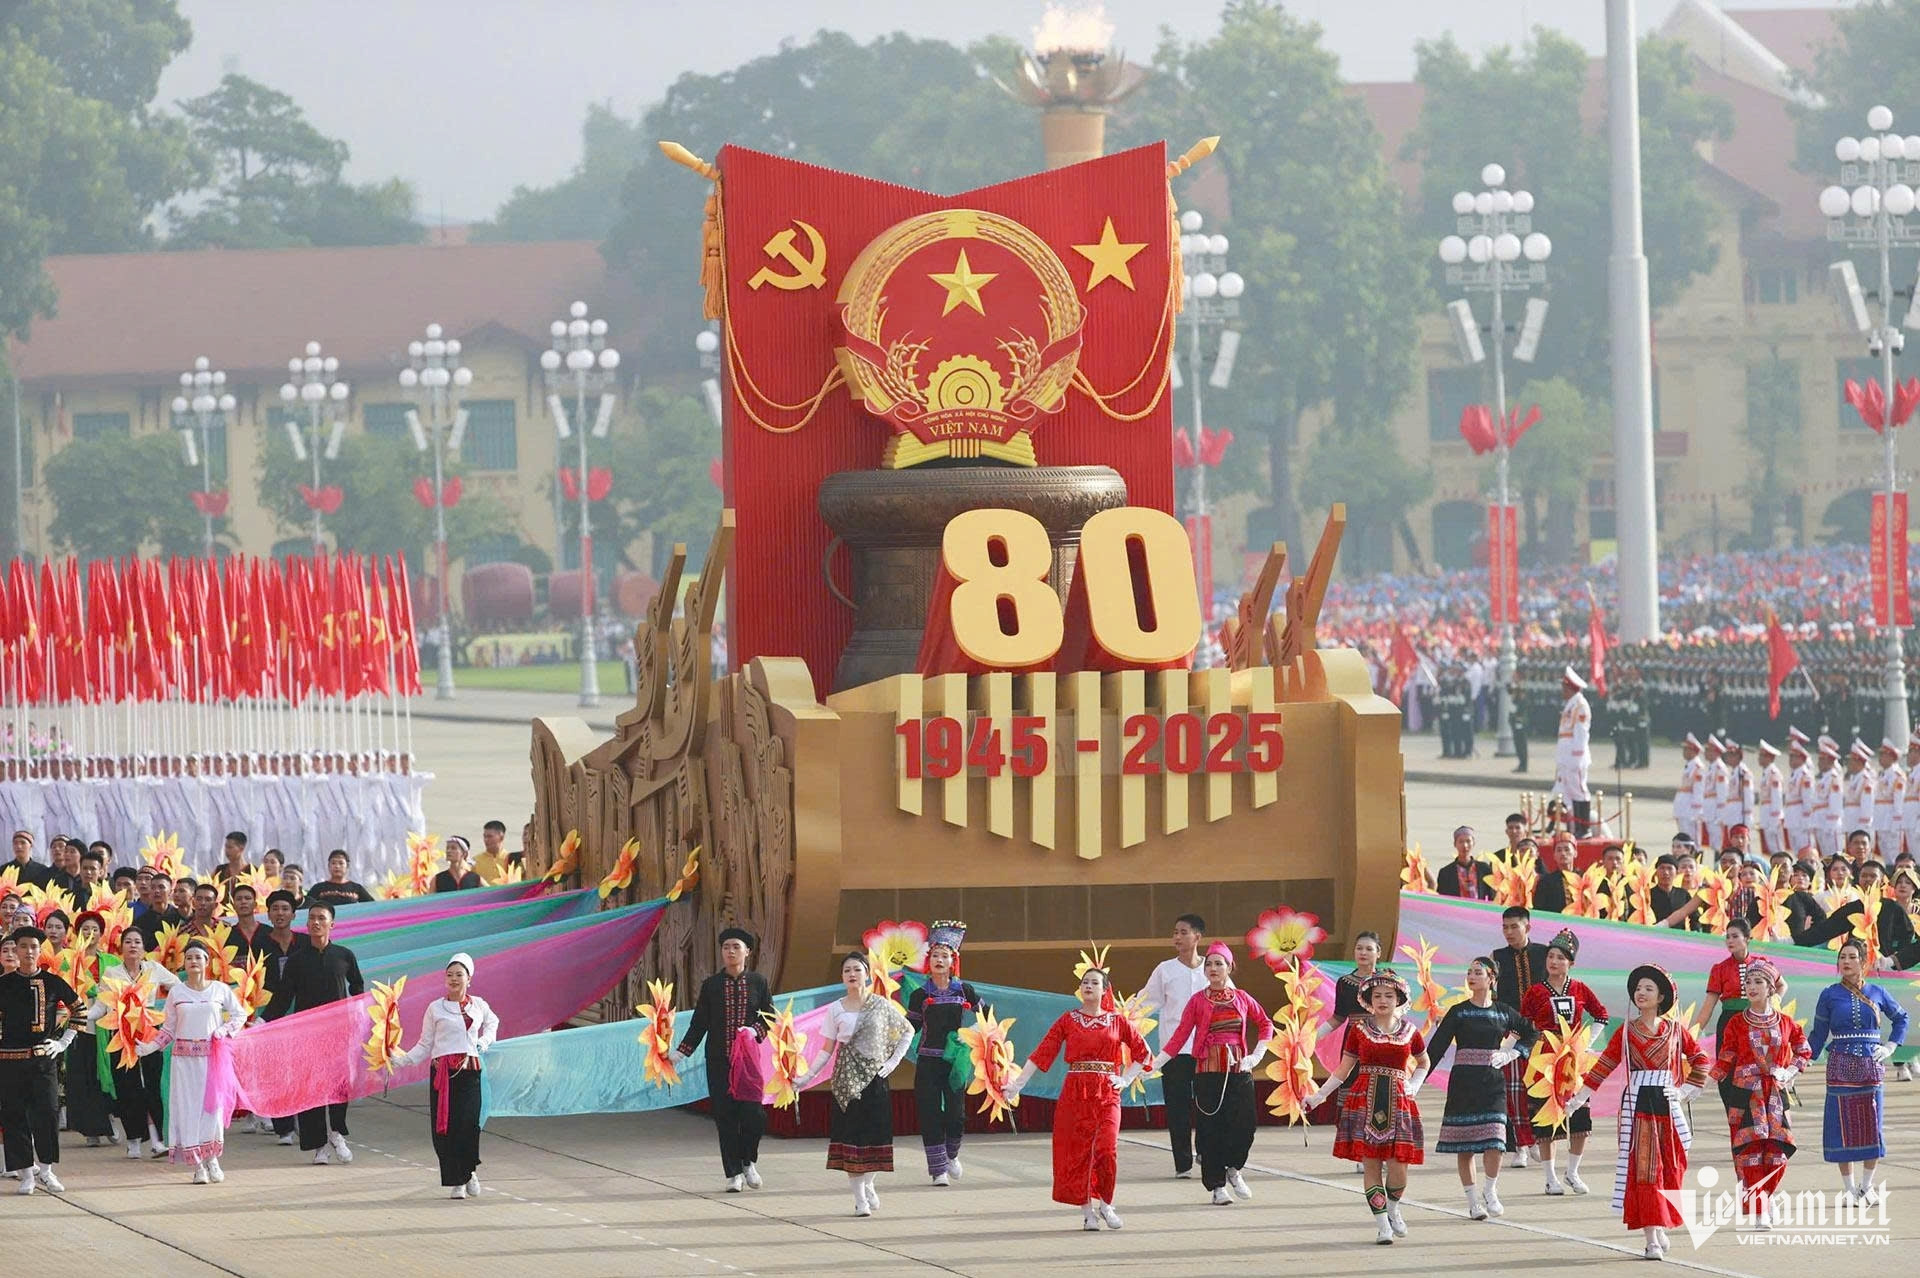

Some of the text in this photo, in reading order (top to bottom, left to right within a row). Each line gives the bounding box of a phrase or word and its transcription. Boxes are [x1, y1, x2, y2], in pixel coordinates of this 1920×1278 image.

[929, 420, 1004, 437] VIỆT NAM
[943, 506, 1202, 667] 80
[895, 712, 1285, 779] 1945 - 2025
